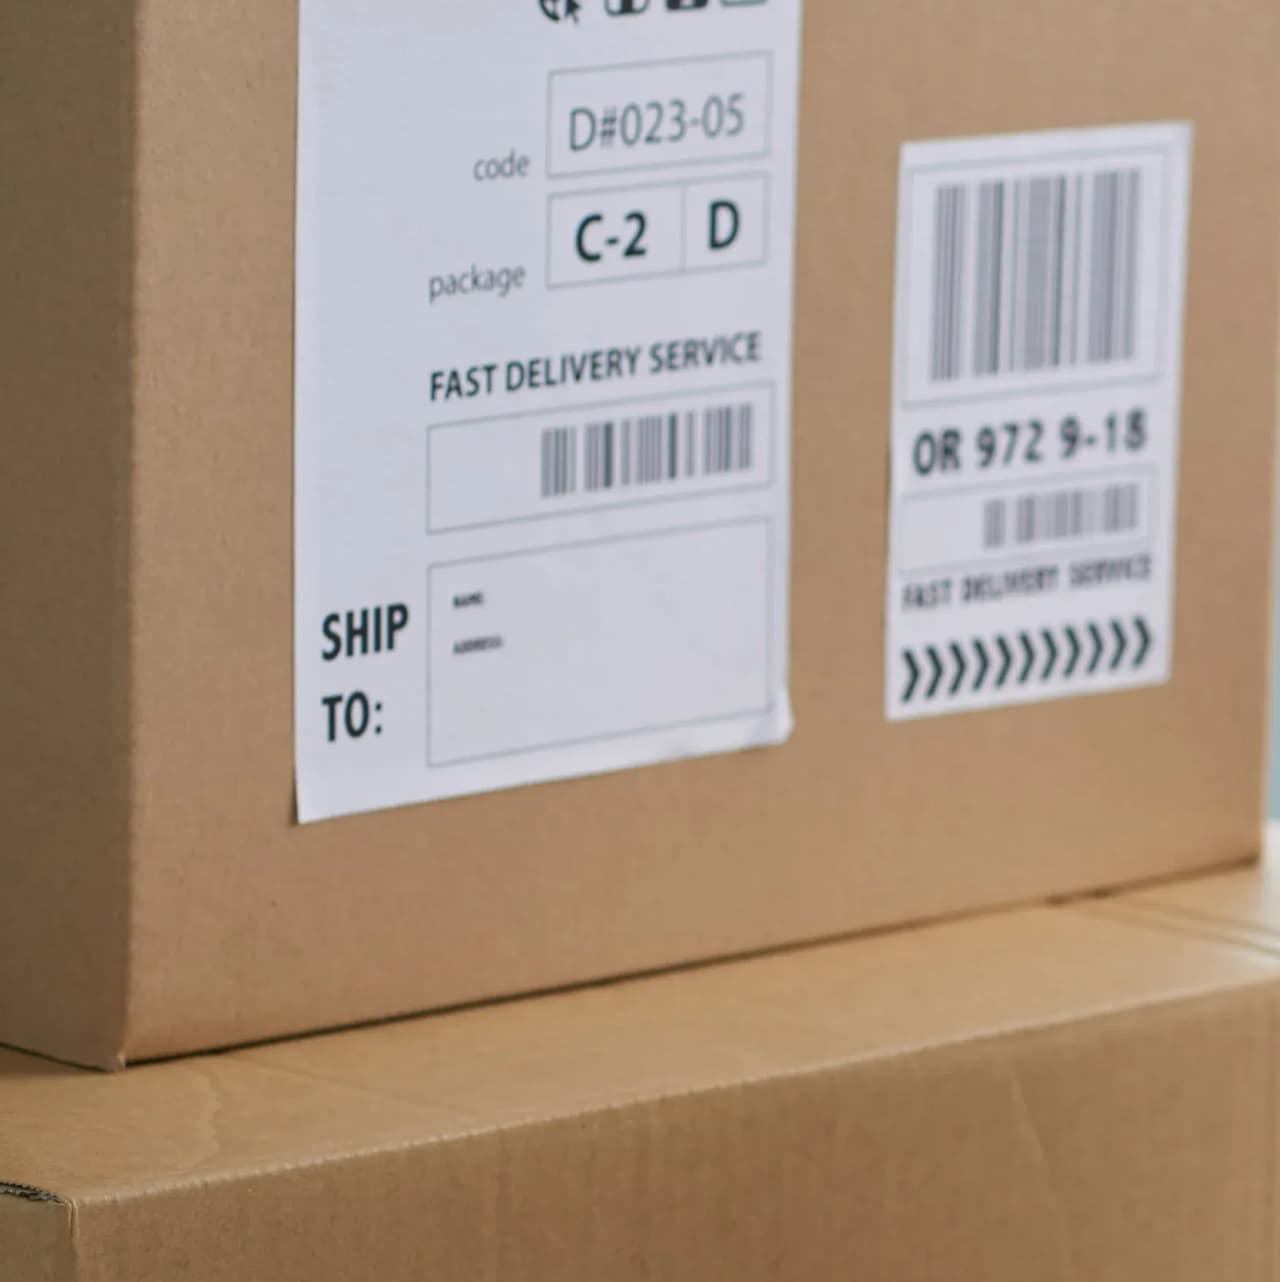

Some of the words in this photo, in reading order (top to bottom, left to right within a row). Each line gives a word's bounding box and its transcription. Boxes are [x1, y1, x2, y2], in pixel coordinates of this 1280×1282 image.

[568, 92, 744, 153] D#023-05
[472, 149, 531, 182] code
[575, 211, 647, 263] C-2
[708, 199, 741, 251] D
[428, 264, 526, 305] package
[430, 363, 498, 402] FAST
[505, 347, 641, 393] DELIVERY
[648, 331, 760, 374] SERVICE
[912, 428, 962, 477] OR
[975, 419, 1044, 469] 972
[321, 602, 409, 662] SHIP
[321, 690, 383, 743] TO:
